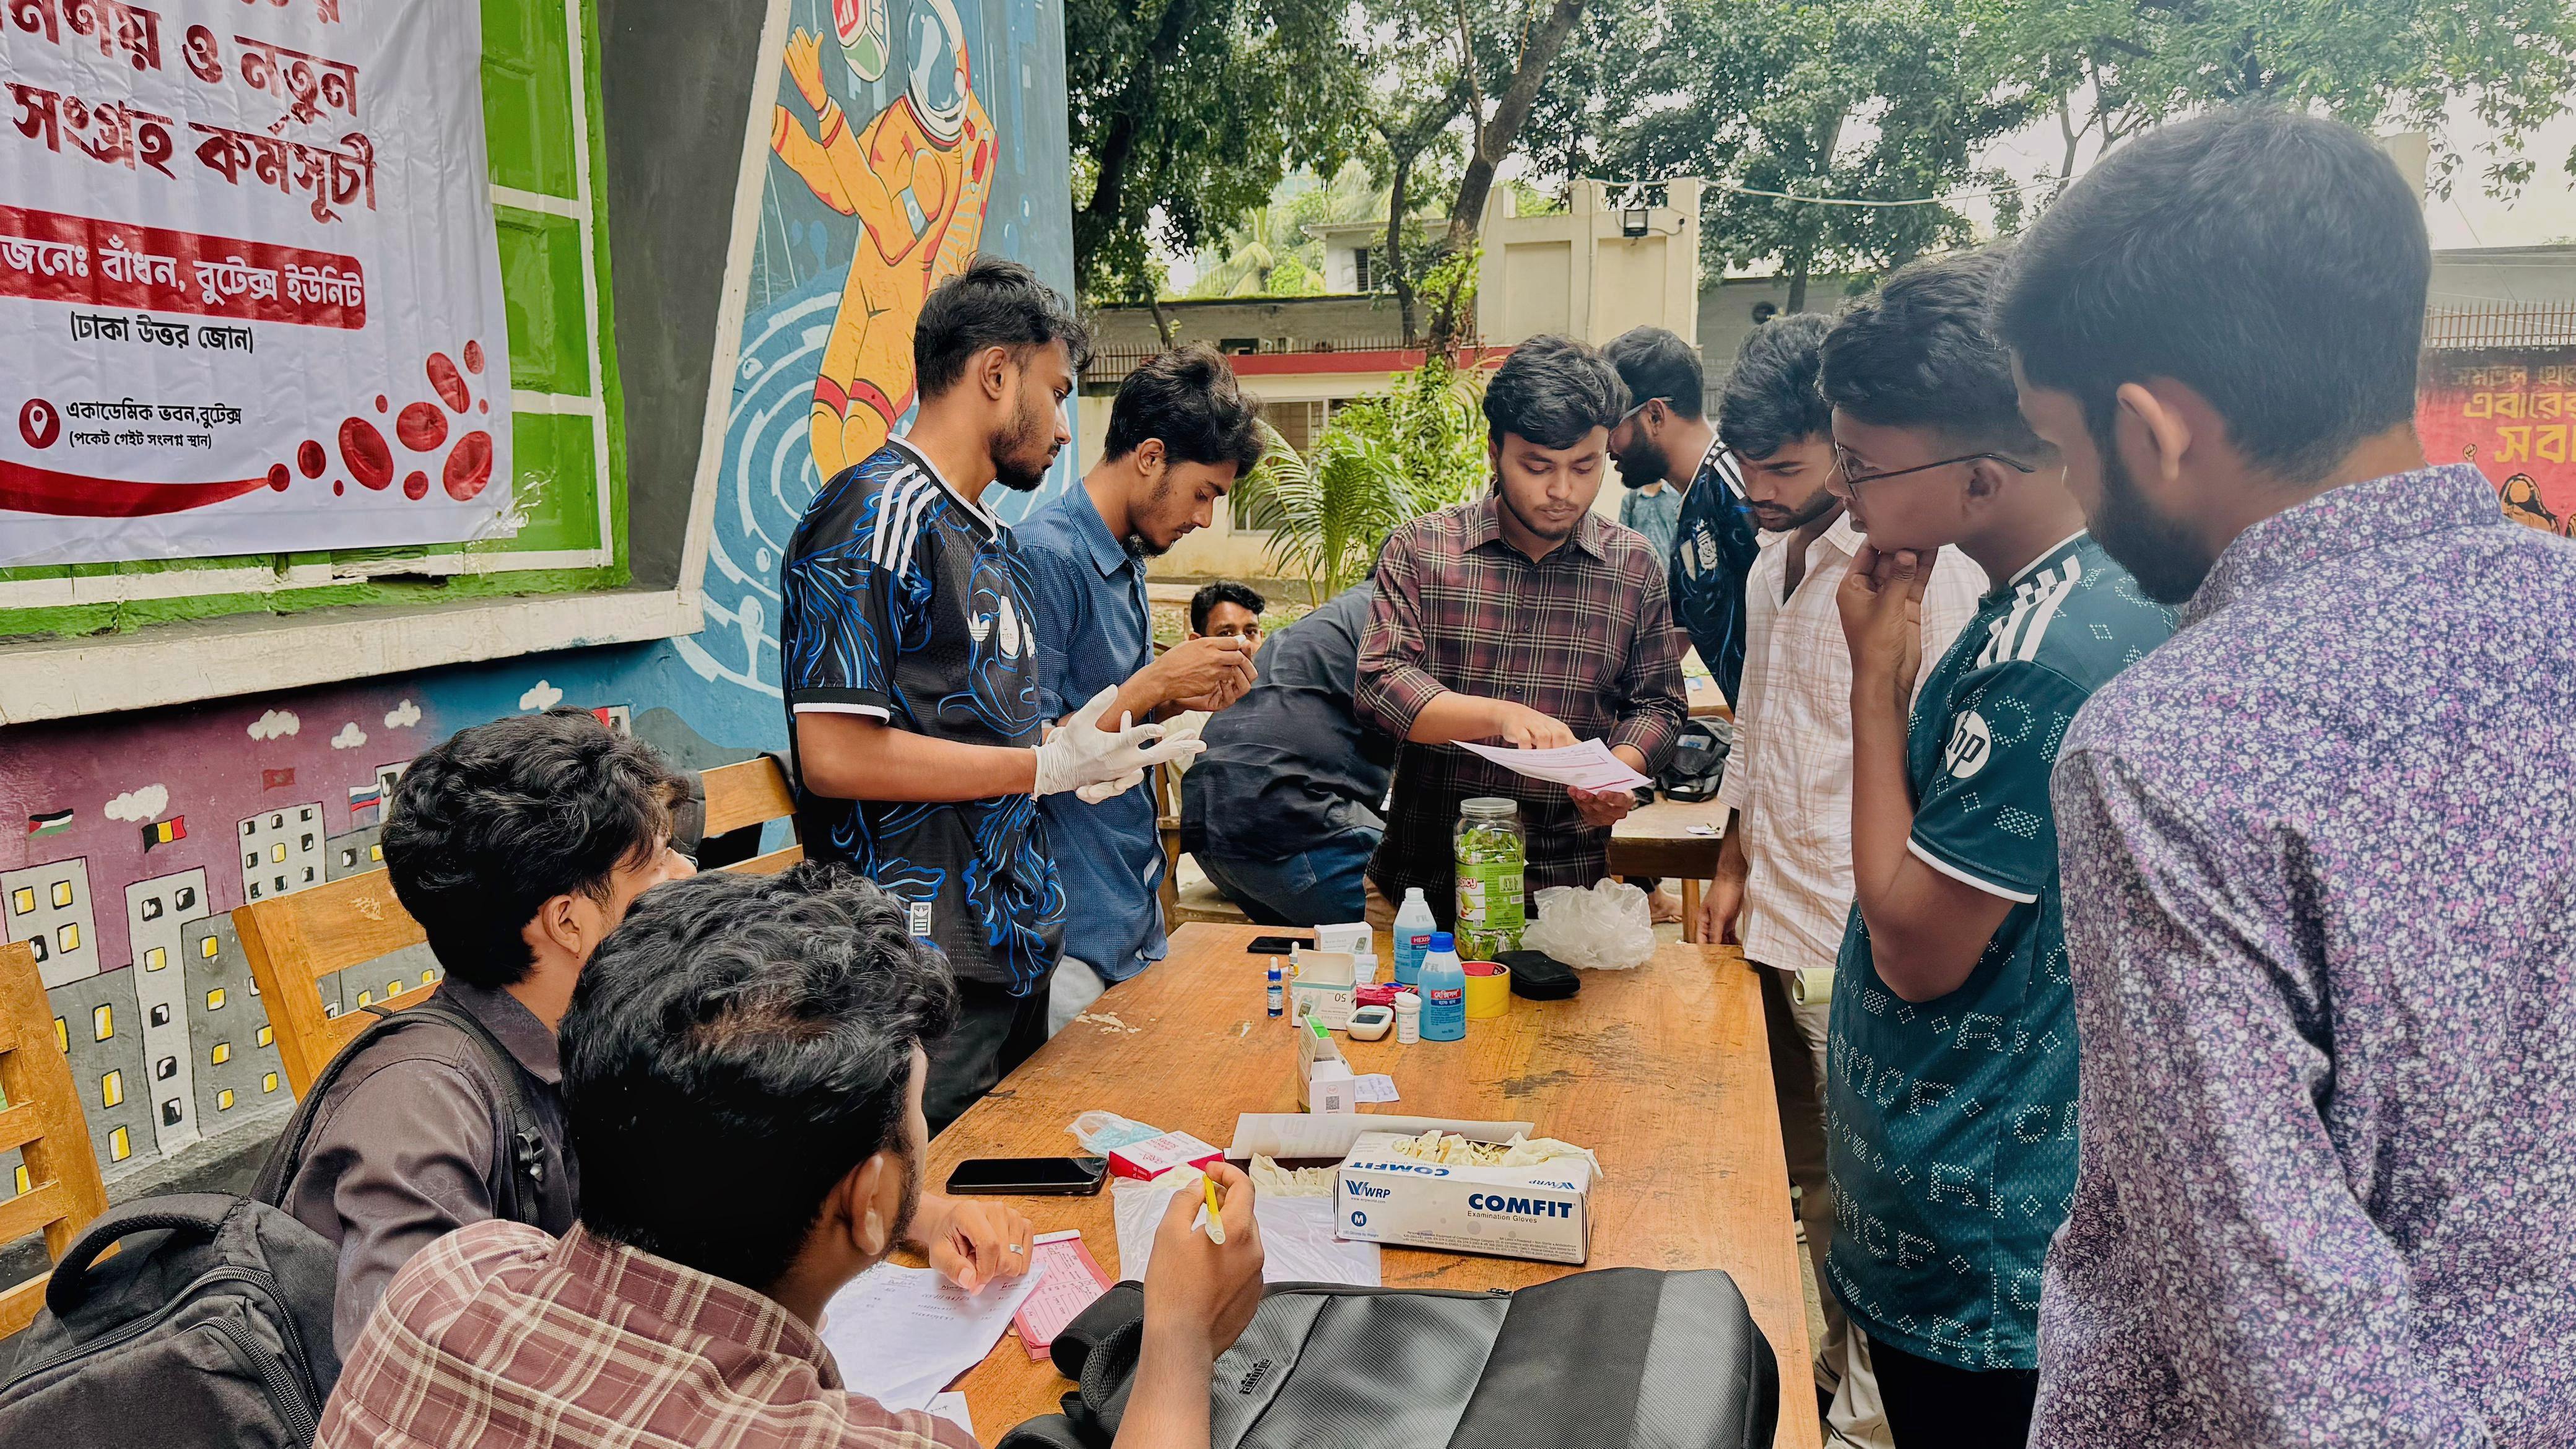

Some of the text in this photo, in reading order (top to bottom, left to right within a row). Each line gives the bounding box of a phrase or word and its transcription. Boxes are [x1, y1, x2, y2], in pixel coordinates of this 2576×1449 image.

[181, 24, 223, 84] ও
[233, 35, 360, 124] নতুন
[3, 81, 377, 224] সংগ্রহ কর্মসূচী
[98, 234, 186, 294] বাঁধন,
[193, 255, 277, 307] বুটেক্স
[285, 263, 362, 307] ইউনিট
[71, 311, 254, 354] (ঢাকা উত্তর জোন)
[66, 398, 154, 420] একাডেমিক
[69, 429, 212, 450] (পকেট গেইট সংলগ্ন স্থান)
[1349, 1162, 1450, 1176] COMFIT
[1468, 1193, 1573, 1219] COMFIT
[1468, 1211, 1538, 1224] Examination Gloves
[1354, 1214, 1364, 1224] M
